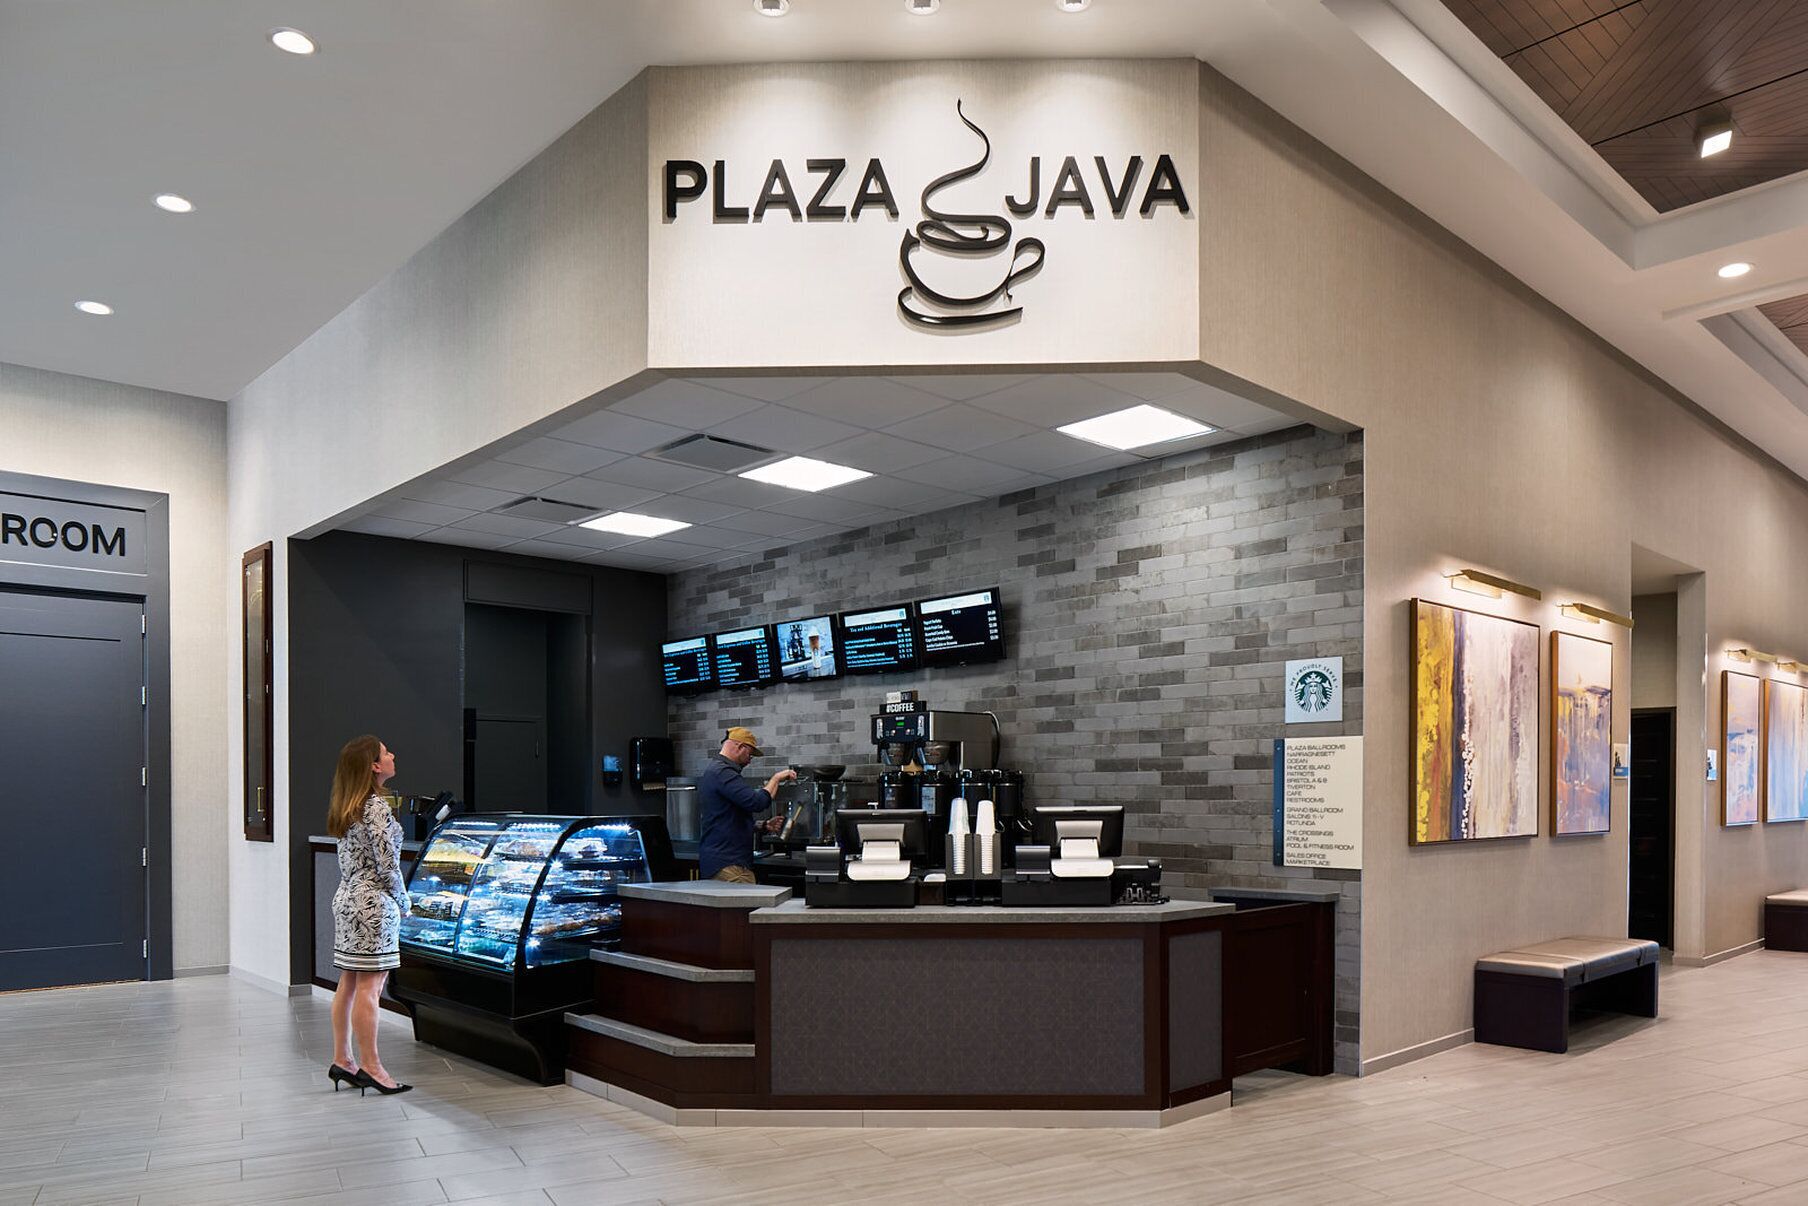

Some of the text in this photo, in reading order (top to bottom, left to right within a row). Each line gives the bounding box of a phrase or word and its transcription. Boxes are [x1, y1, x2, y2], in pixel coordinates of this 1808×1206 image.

[664, 154, 1190, 221] PLAZA JAVA
[1, 512, 126, 557] ROOM
